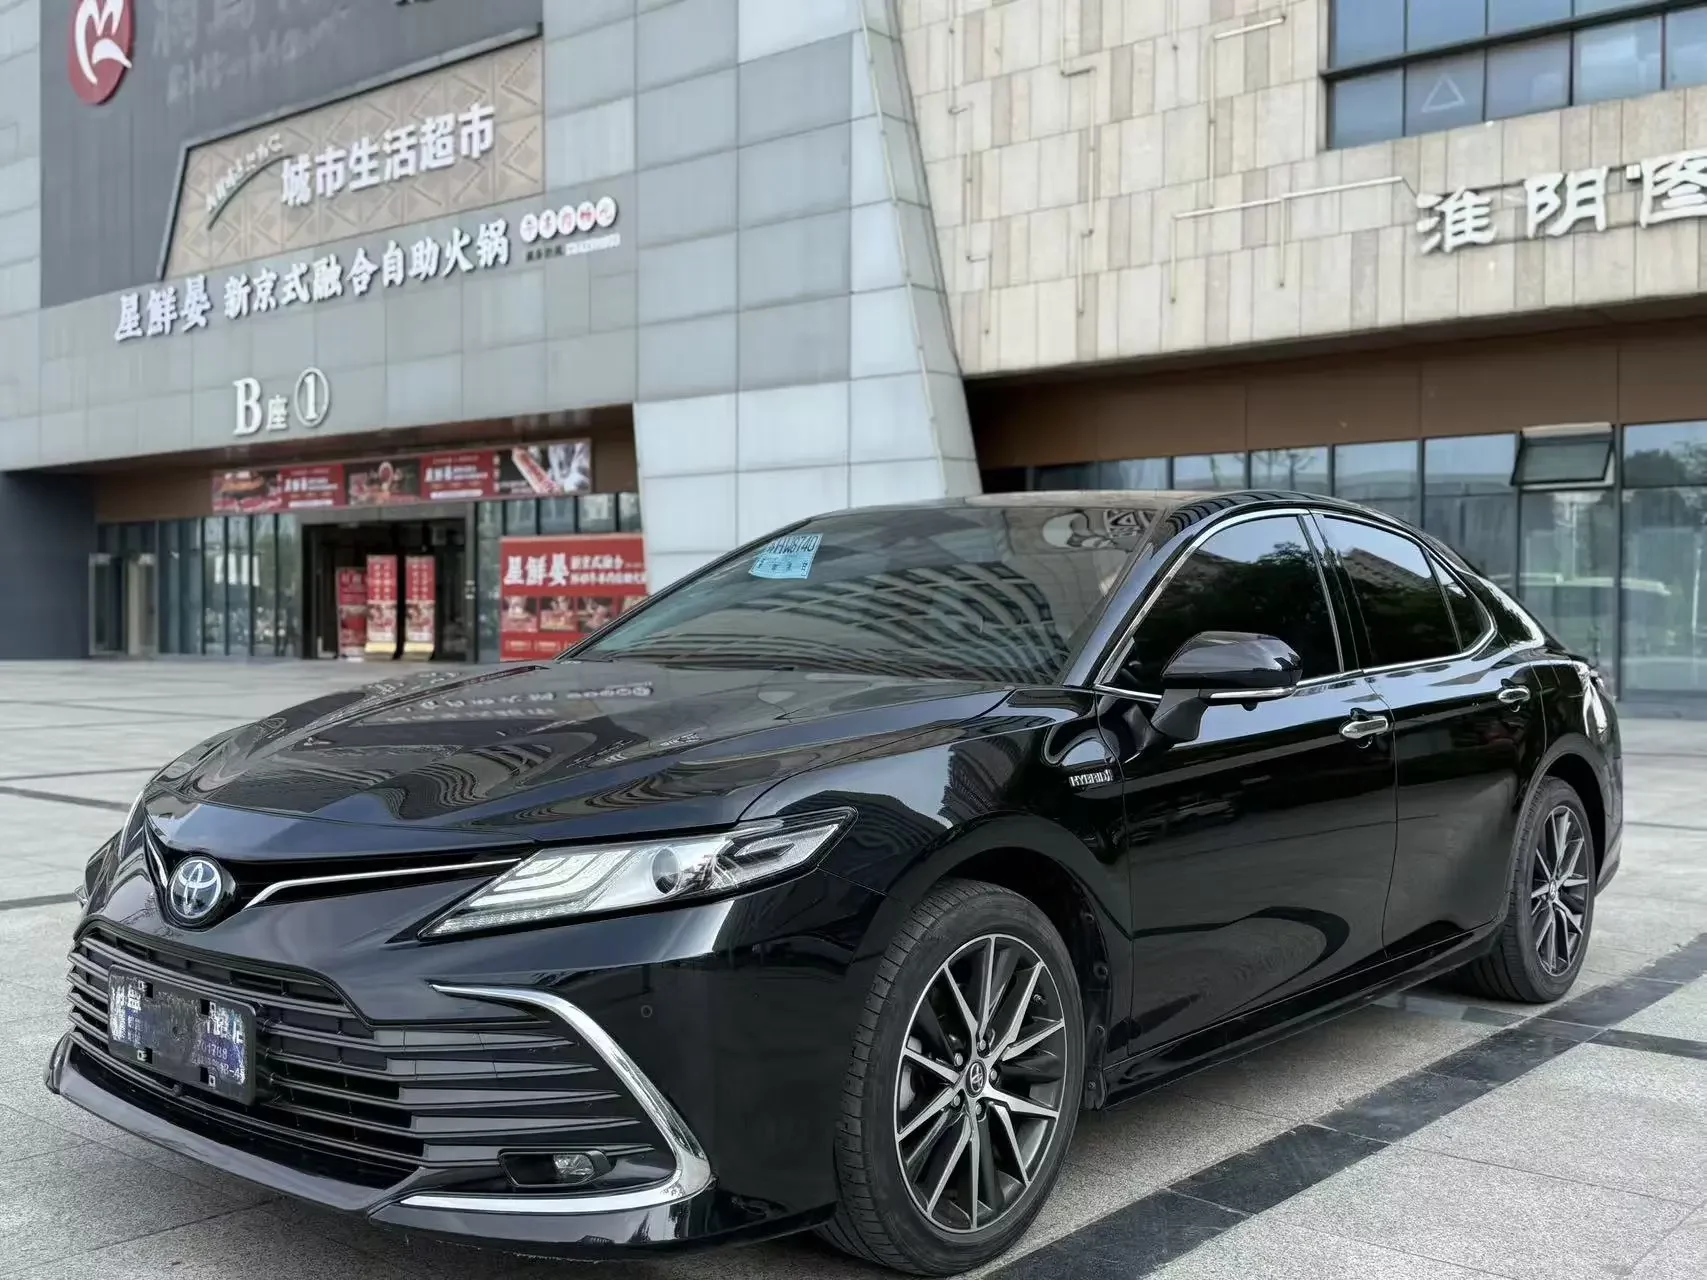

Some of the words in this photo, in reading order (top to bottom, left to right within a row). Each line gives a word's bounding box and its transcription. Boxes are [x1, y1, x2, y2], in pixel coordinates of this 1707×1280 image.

[281, 102, 496, 207] 城市生活超市
[1416, 147, 1707, 254] 淮阴图
[223, 219, 511, 319] 新京式融合自助火锅
[1069, 769, 1113, 787] HYBRID
